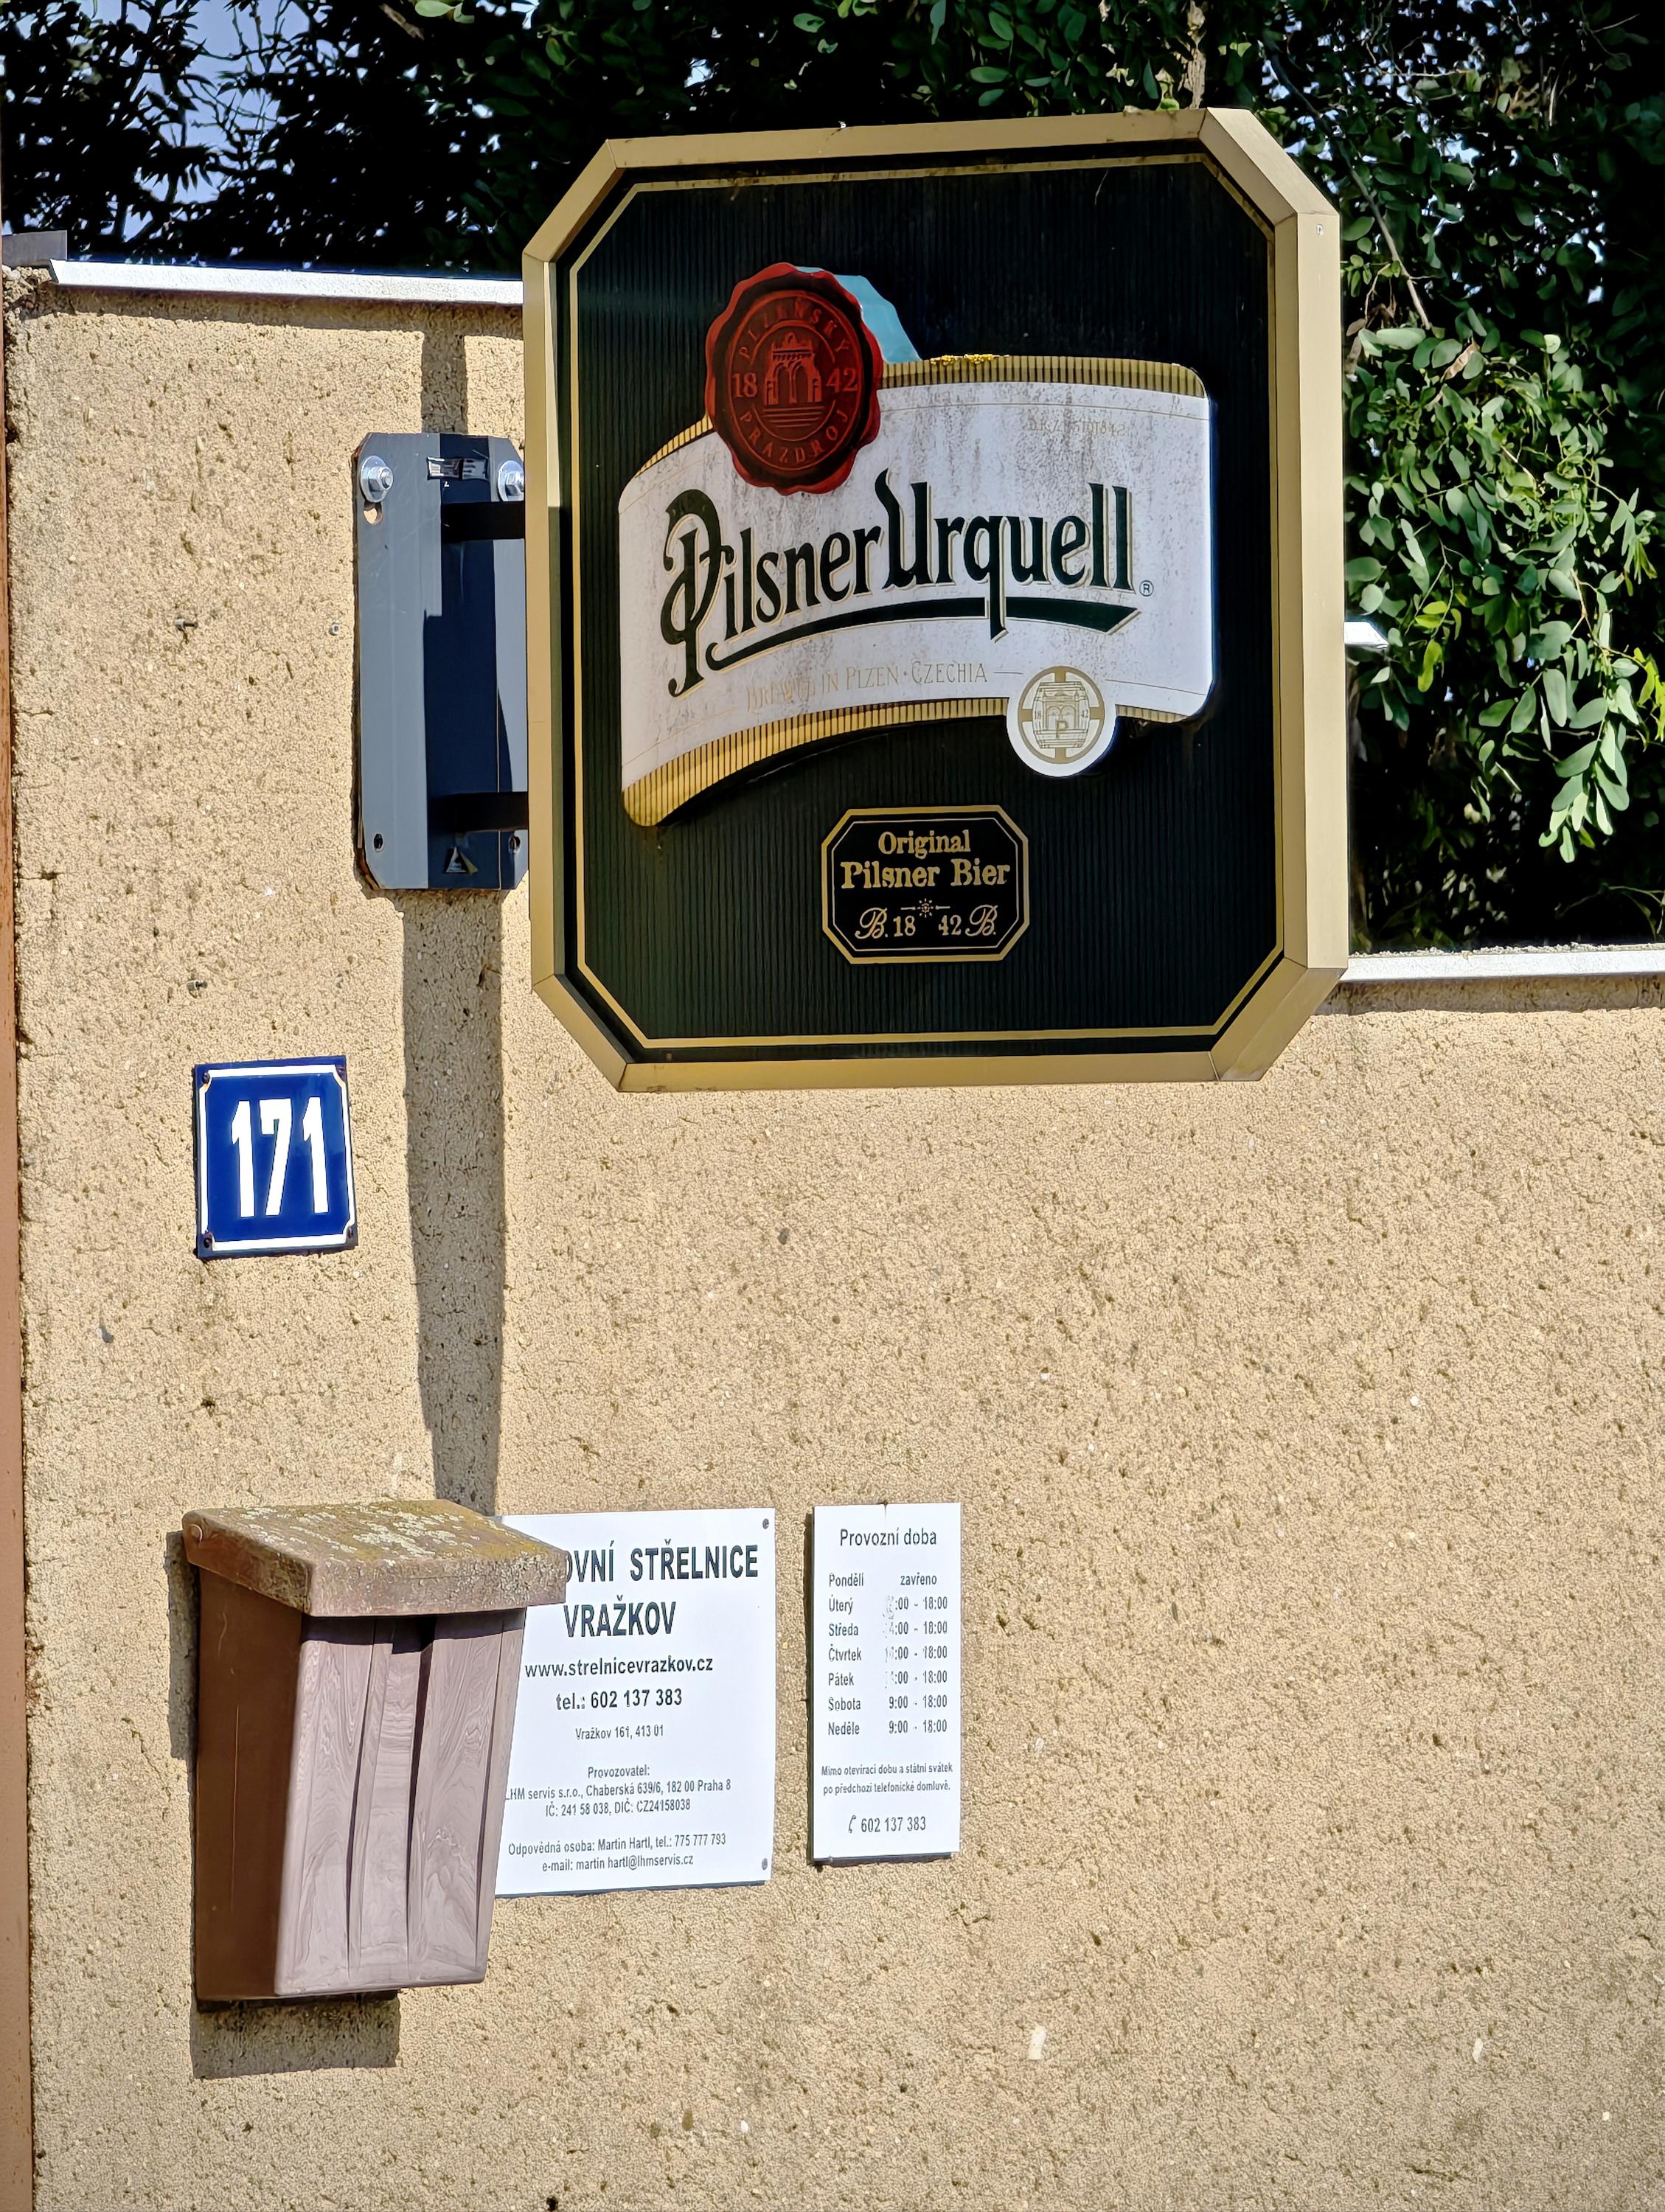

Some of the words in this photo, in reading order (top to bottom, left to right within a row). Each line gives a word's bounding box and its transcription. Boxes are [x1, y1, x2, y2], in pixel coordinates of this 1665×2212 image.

[731, 372, 758, 397] 18
[826, 368, 858, 393] 42
[740, 409, 848, 463] PRAZDROJ
[661, 489, 882, 698] Pilsner
[875, 467, 1136, 640] Urquell
[821, 671, 839, 695] IN
[911, 661, 988, 685] CZECHIA
[878, 830, 971, 859] Original
[840, 860, 940, 888] Pilsner
[950, 858, 1010, 886] Bier
[893, 916, 916, 937] 18
[938, 915, 962, 936] 42
[231, 1096, 329, 1218] 171
[840, 1527, 899, 1546] Provozní
[903, 1527, 937, 1545] doba
[630, 1538, 759, 1581] STŘELNICE
[829, 1571, 863, 1587] Pondělí
[900, 1572, 937, 1585] zavřeno
[829, 1593, 854, 1615] Úterý
[922, 1596, 948, 1610] 18:00
[563, 1594, 677, 1638] VRAŽKOV
[828, 1622, 859, 1637] Středa
[922, 1621, 948, 1635] 18:00
[828, 1644, 862, 1662] Čtvrtek
[922, 1646, 948, 1660] 18:00
[525, 1655, 714, 1677] www.strelnicevrazkov.cz
[828, 1672, 854, 1686] Pátek
[922, 1670, 948, 1684] 18:00
[556, 1692, 585, 1710] tel.:
[591, 1691, 617, 1708] 602
[624, 1689, 650, 1708] 137
[656, 1688, 683, 1705] 383
[828, 1697, 861, 1711] Sobota
[889, 1695, 908, 1709] 9:00
[922, 1694, 948, 1708] 18:00
[575, 1726, 611, 1740] Vražkov
[614, 1725, 633, 1740] 161,
[635, 1725, 650, 1737] 413
[653, 1724, 664, 1736] 01
[828, 1721, 860, 1736] Neděle
[889, 1720, 908, 1734] 9:00
[922, 1719, 948, 1733] 18:00
[588, 1764, 650, 1778] Provozovatel:
[821, 1765, 842, 1776] Mimo
[878, 1764, 897, 1775] dobu
[899, 1765, 904, 1774] a
[928, 1761, 953, 1773] svátek
[528, 1787, 555, 1800] servis
[558, 1788, 583, 1800] s.r.o.,
[585, 1782, 634, 1797] Chaberská
[637, 1781, 664, 1795] 639/6,
[667, 1780, 682, 1793] 182
[684, 1780, 695, 1792] 00
[698, 1778, 723, 1792] Praha
[726, 1778, 731, 1790] 8
[823, 1786, 833, 1797] po
[835, 1782, 872, 1796] předchozí
[874, 1781, 915, 1793] telefonické
[917, 1779, 950, 1791] domluvě.
[546, 1801, 558, 1817] IČ:
[561, 1804, 577, 1817] 241
[580, 1803, 591, 1815] 58
[614, 1798, 633, 1814] DIČ:
[636, 1798, 691, 1813] CZ24158038
[861, 1818, 880, 1832] 602
[885, 1817, 903, 1832] 137
[907, 1816, 926, 1832] 383
[508, 1840, 561, 1857] Odpovědná
[564, 1839, 595, 1853] osoba:
[597, 1837, 626, 1851] Martin
[629, 1836, 653, 1850] Hartl,
[656, 1835, 672, 1848] tel.:
[675, 1834, 691, 1847] 775
[693, 1834, 709, 1846] 777
[711, 1833, 726, 1846] 793
[542, 1858, 574, 1872] e-mail:
